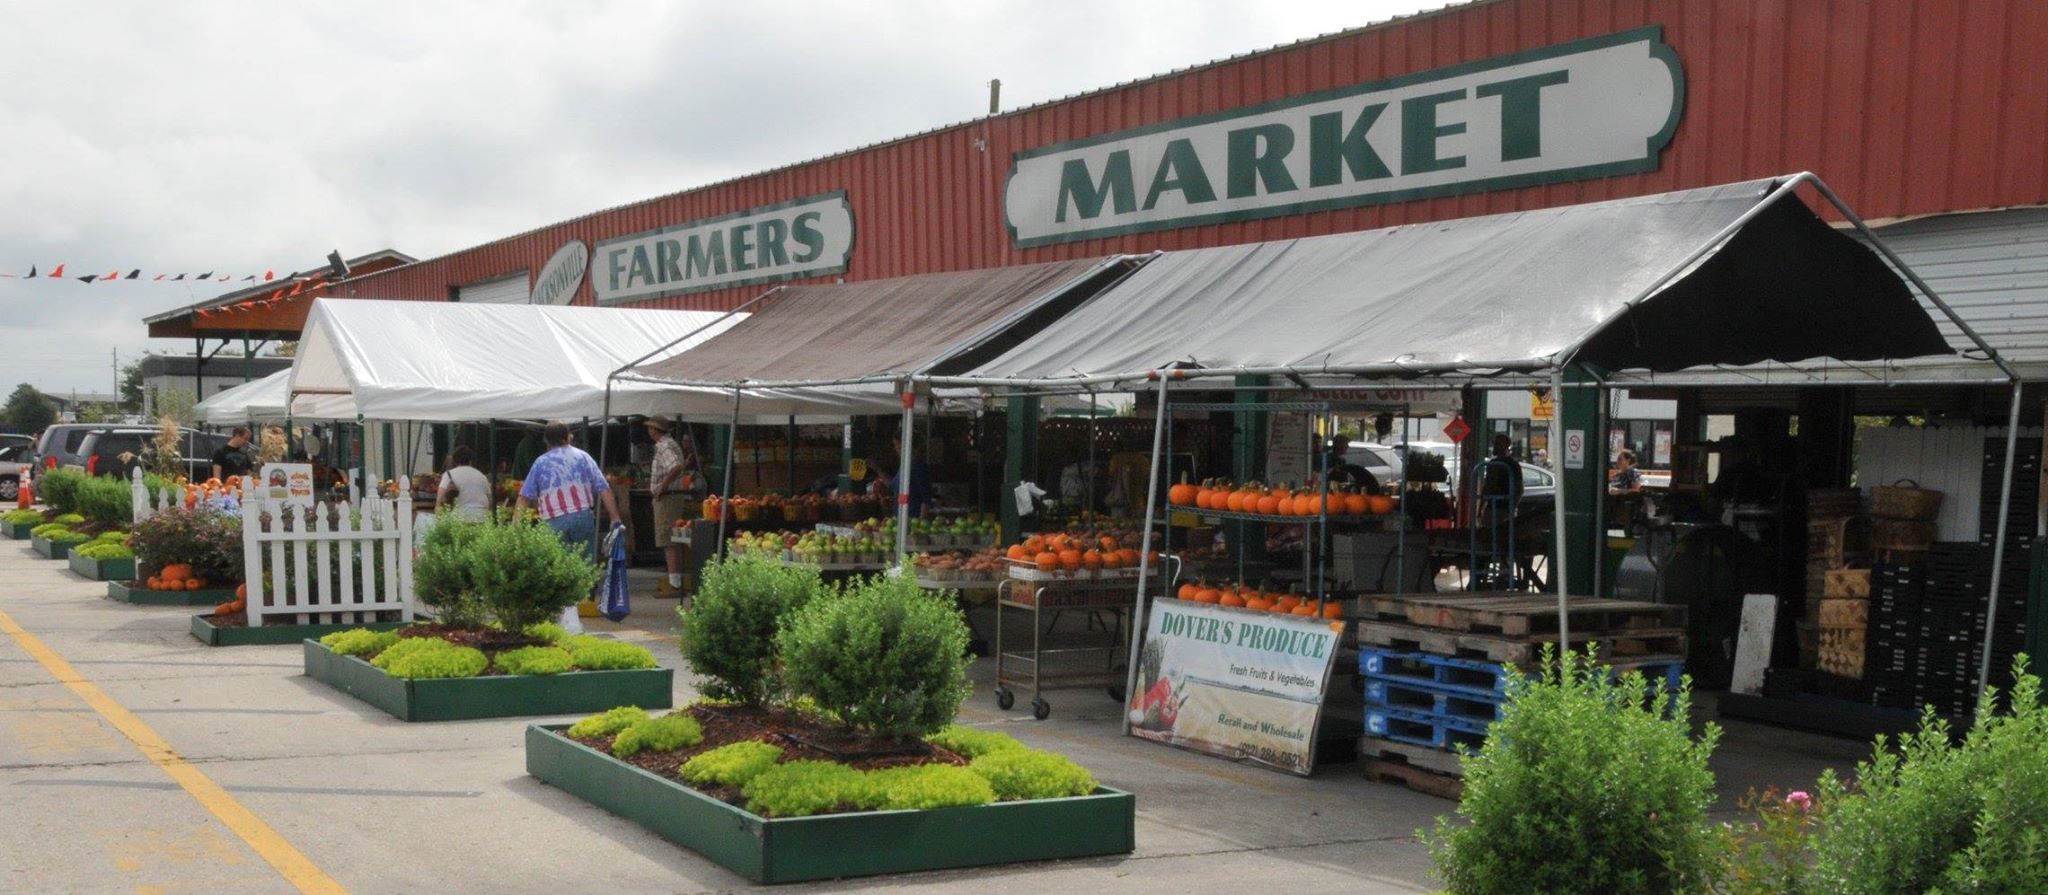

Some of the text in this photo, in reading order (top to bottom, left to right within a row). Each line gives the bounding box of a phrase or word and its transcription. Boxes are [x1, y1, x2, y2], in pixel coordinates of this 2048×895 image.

[1055, 69, 1569, 223] MARKET
[609, 211, 824, 291] FARMERS
[1160, 611, 1328, 659] DOVER'S PRODUCE
[1230, 663, 1248, 676] Fresh
[1250, 667, 1268, 680] Fruits
[1277, 672, 1315, 688] Vegetables
[1243, 720, 1259, 731] and
[1261, 721, 1305, 741] Wholesale
